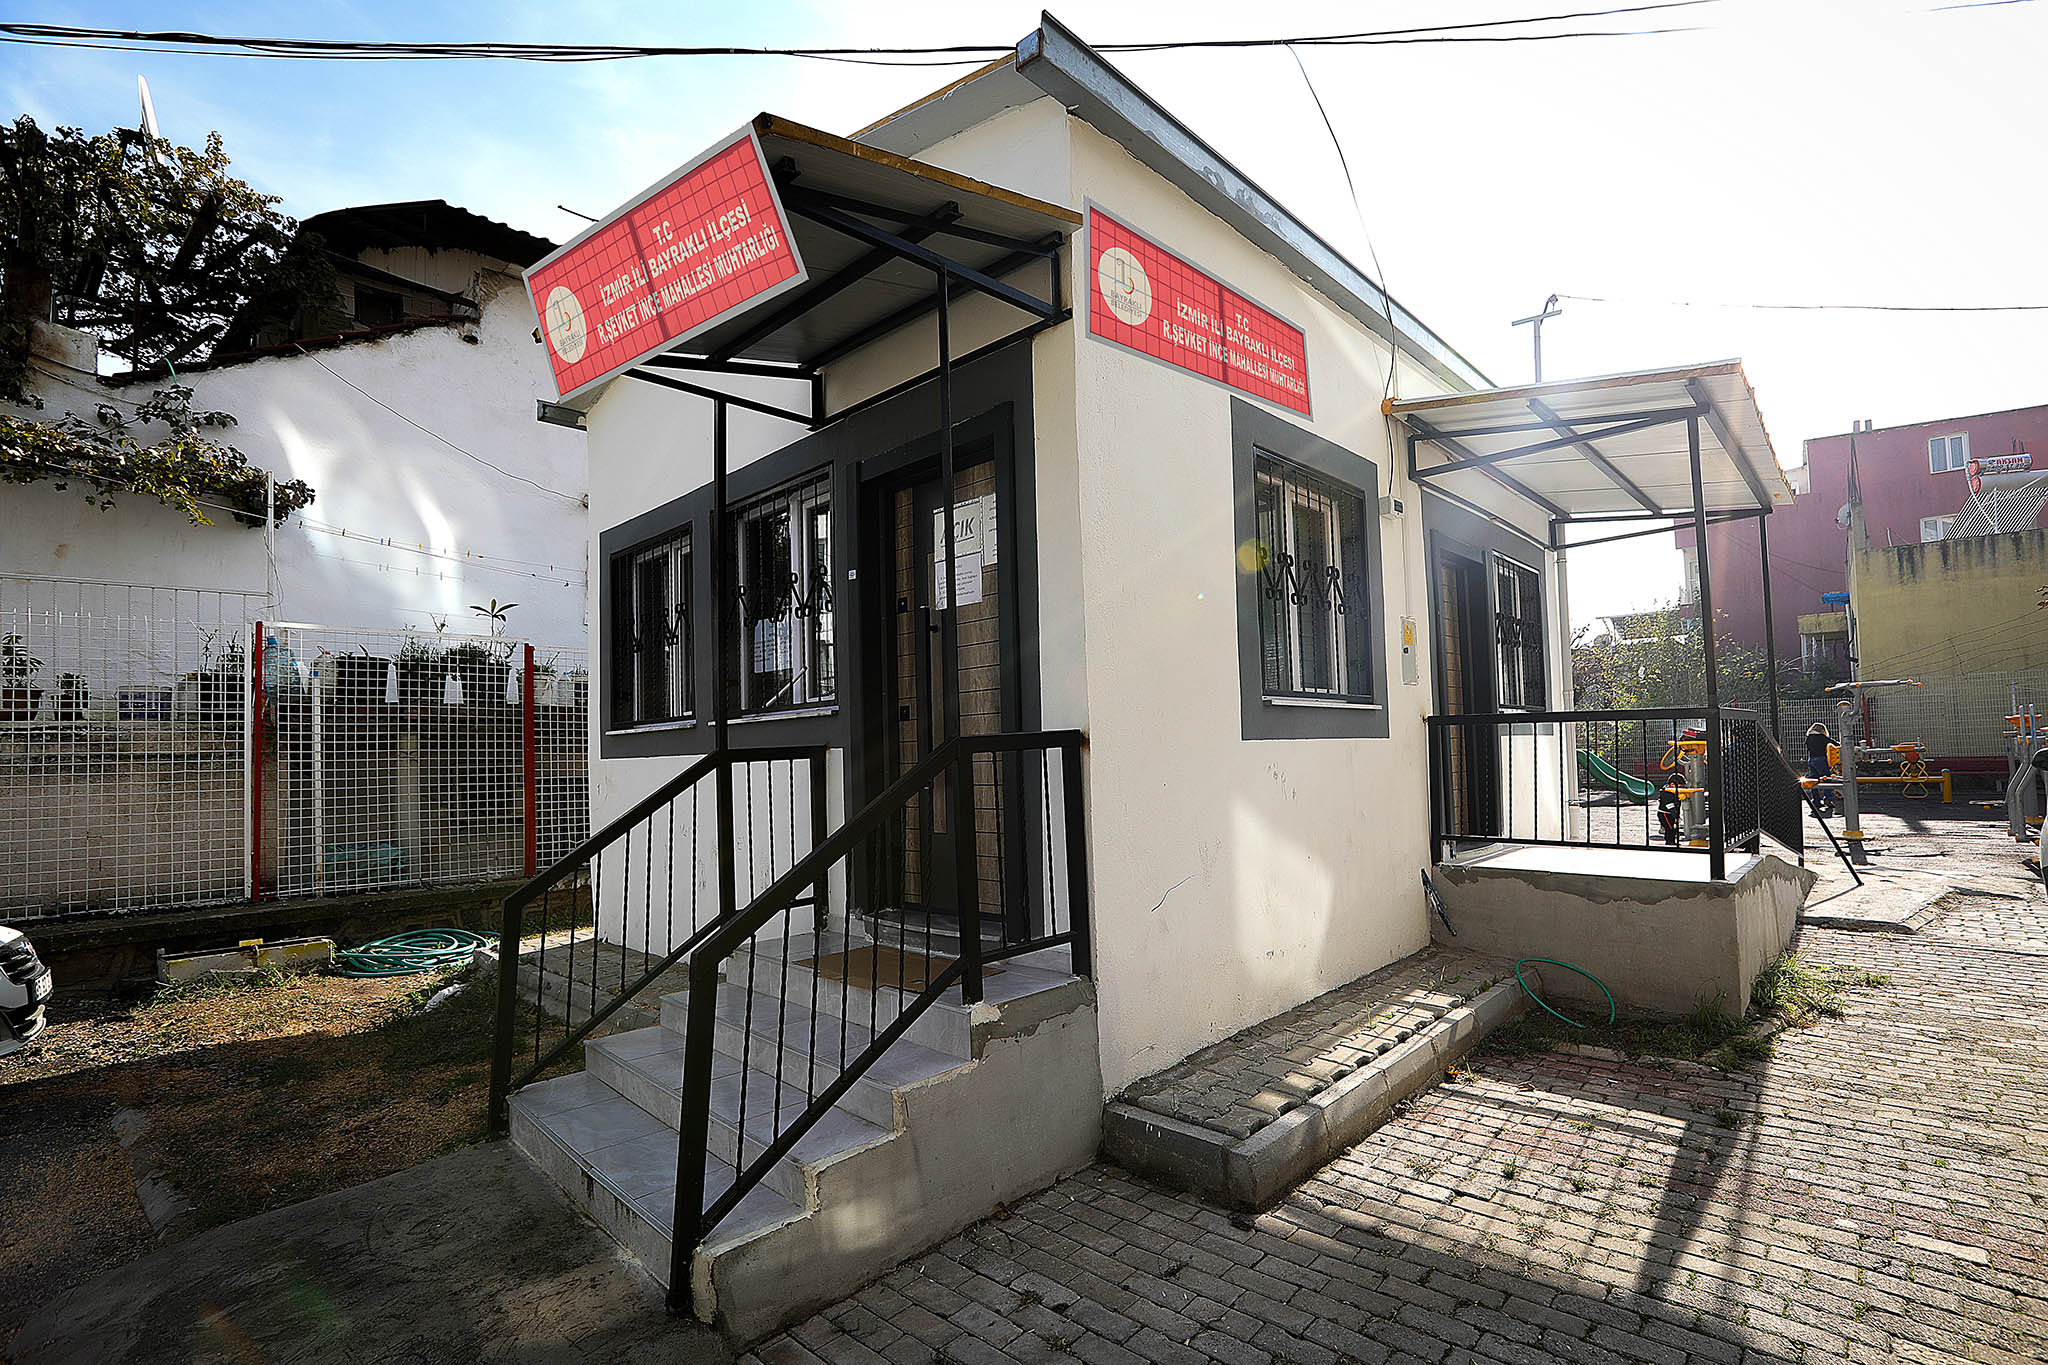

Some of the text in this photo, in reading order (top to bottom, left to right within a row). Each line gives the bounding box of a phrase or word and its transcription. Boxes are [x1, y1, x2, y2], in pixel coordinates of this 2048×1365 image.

[599, 273, 633, 307] İZMİR
[648, 228, 709, 278] BAYRAKLI
[706, 198, 752, 243] İLÇESİ
[652, 220, 673, 246] T.C
[636, 290, 663, 322] İNCE
[660, 256, 717, 308] MAHALLESİ
[714, 222, 780, 278] MUHTARLIĞI
[1176, 297, 1208, 330] İZMİR
[1226, 325, 1270, 359] BAYRAKLI
[1270, 345, 1295, 371] İLÇESİ
[1235, 313, 1249, 332] T.C
[1209, 336, 1229, 364] İNCE
[1229, 349, 1269, 381] MAHALLESİ
